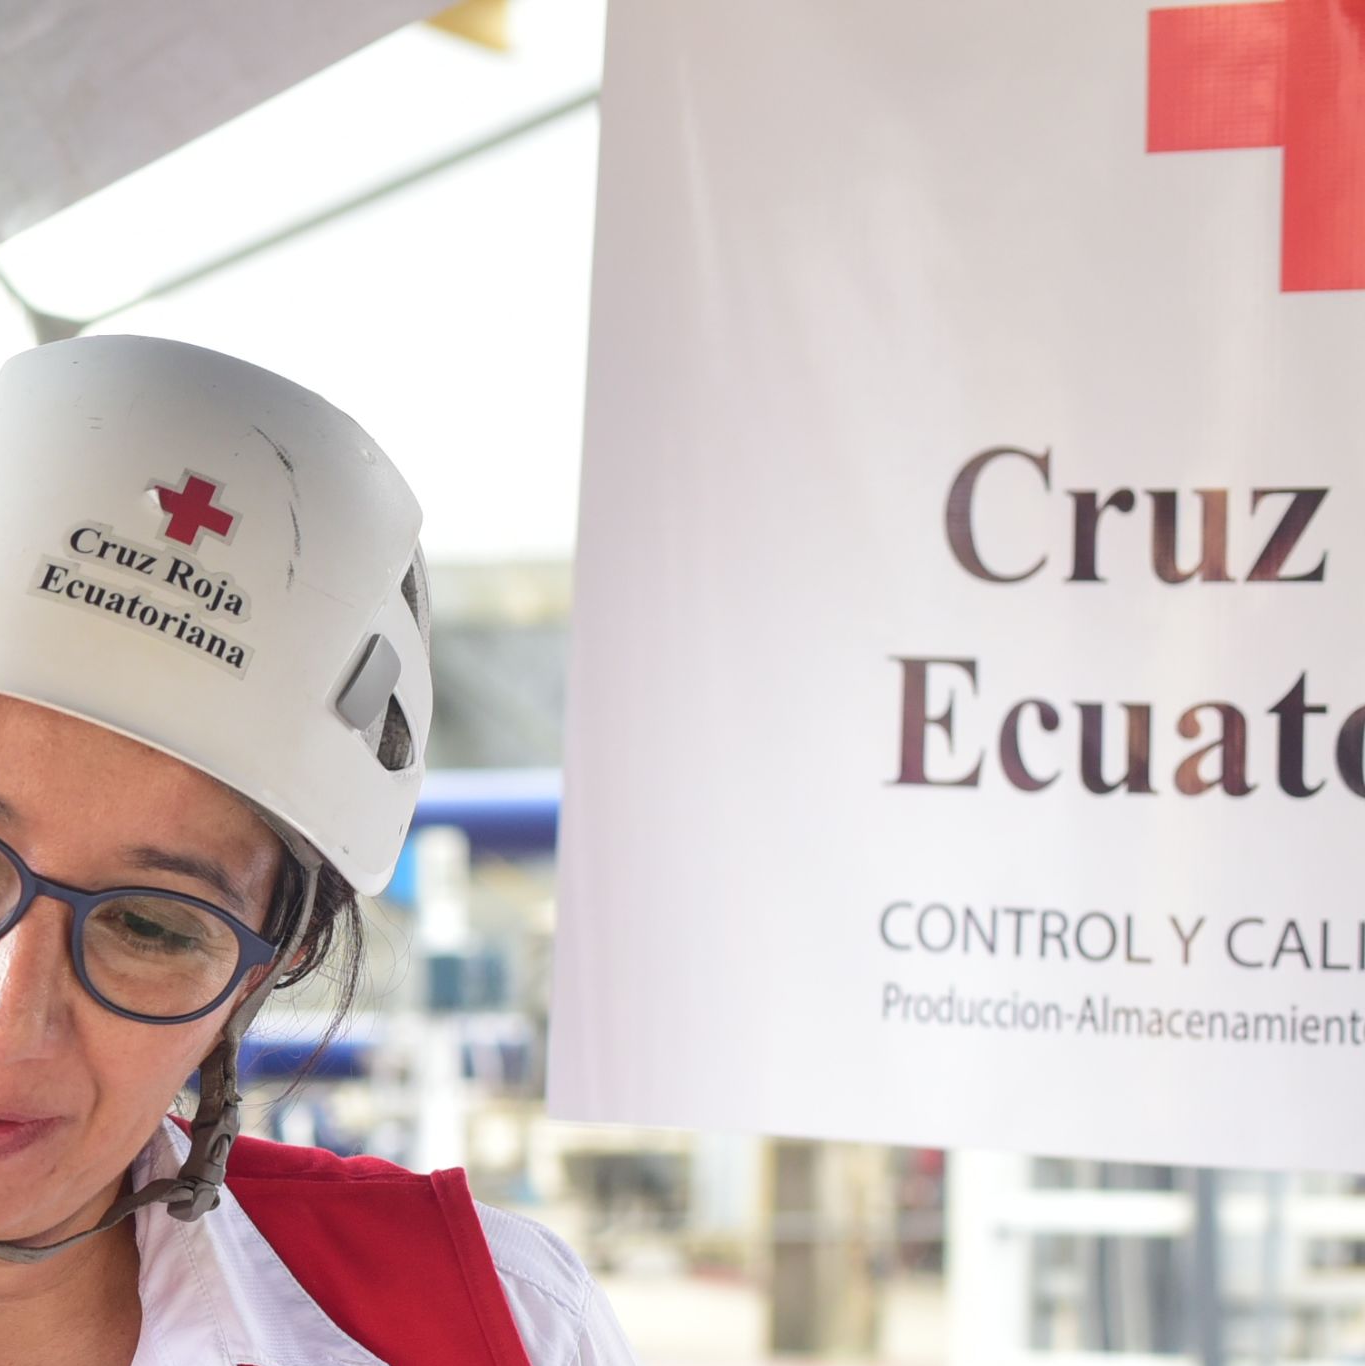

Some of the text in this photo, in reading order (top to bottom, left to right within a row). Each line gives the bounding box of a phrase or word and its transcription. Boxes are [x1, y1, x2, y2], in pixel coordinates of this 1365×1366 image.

[944, 445, 1331, 586] Cruz
[37, 564, 246, 668] Ecuatoriana
[70, 527, 243, 616] Cruz Roja
[879, 900, 1152, 964] CONTROL
[1170, 917, 1205, 965] Y
